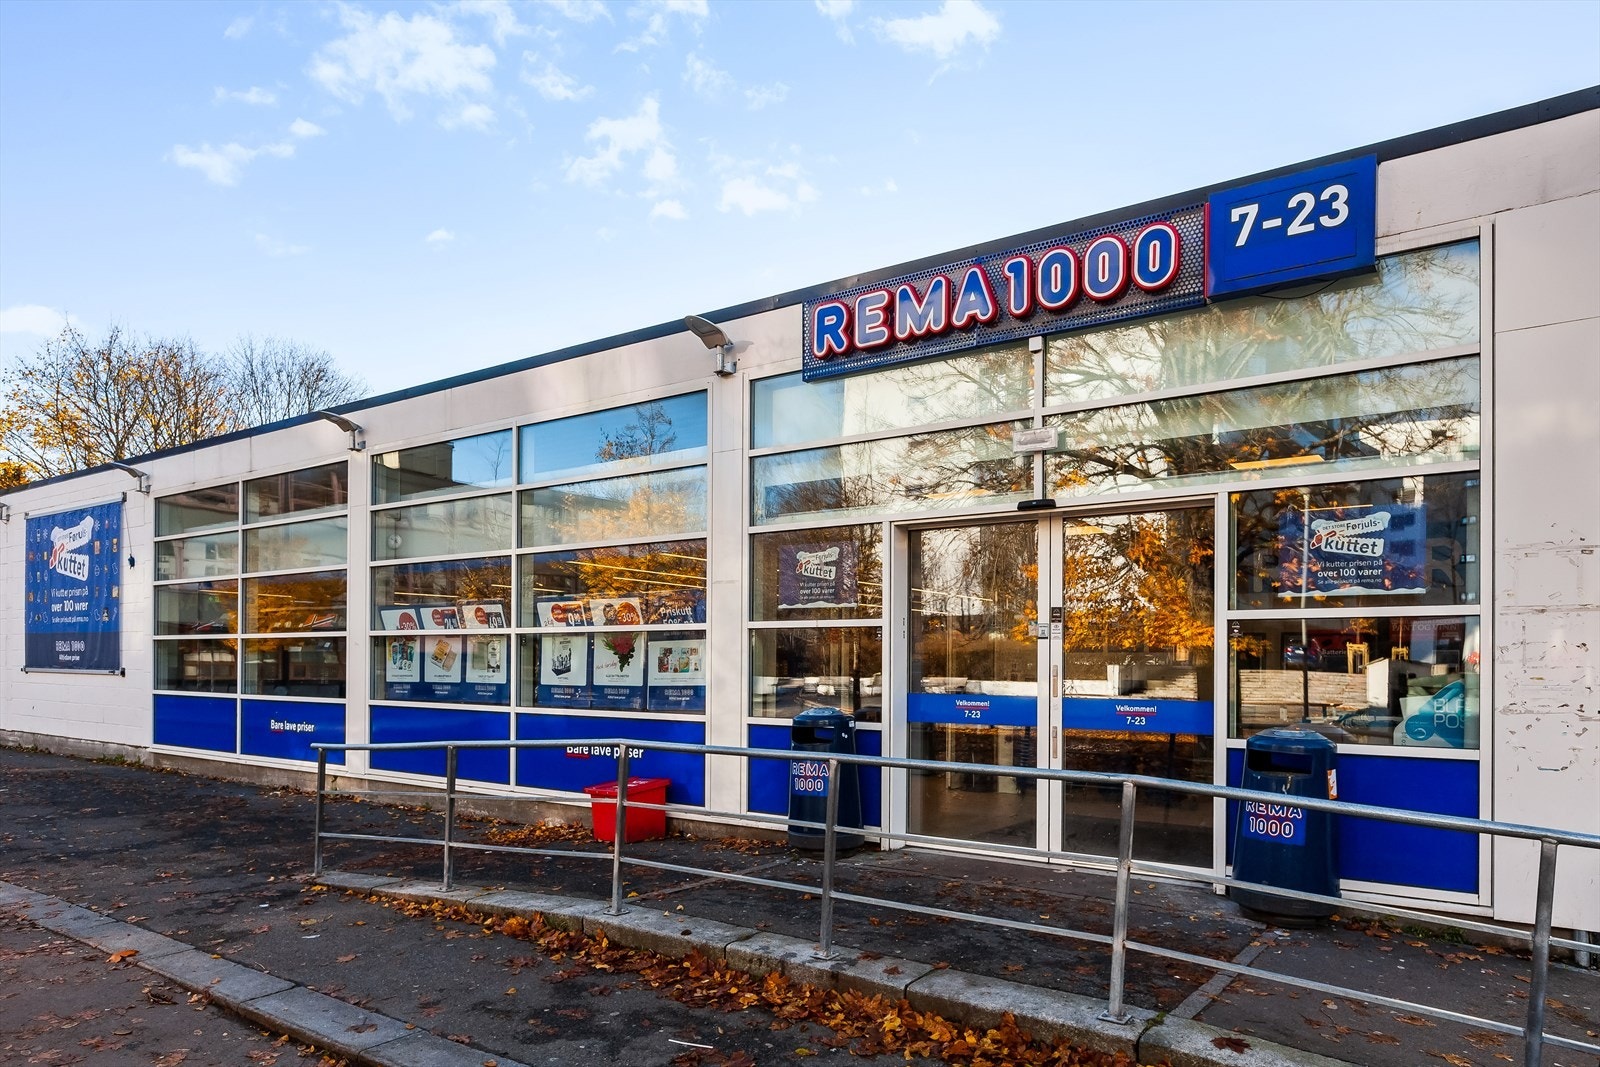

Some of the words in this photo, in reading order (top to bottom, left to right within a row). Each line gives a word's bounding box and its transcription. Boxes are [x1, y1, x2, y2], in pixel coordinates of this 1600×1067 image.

[1230, 184, 1350, 247] 7-23
[813, 263, 998, 359] REMA
[1003, 221, 1182, 320] 1000
[1346, 520, 1380, 530] Førjuls-
[1324, 537, 1378, 554] kuttet
[57, 552, 86, 578] kuttet
[1349, 560, 1371, 568] prisen
[804, 564, 832, 578] kuttet
[1340, 568, 1356, 576] 100
[51, 603, 62, 612] over
[63, 600, 74, 611] 100
[660, 605, 693, 616] Priskutt
[964, 710, 981, 718] 7-23
[1115, 704, 1157, 713] Velkommen!
[270, 719, 284, 729] Bare
[284, 720, 297, 730] lave
[297, 721, 315, 732] priser
[1126, 716, 1146, 725] 7-23
[613, 746, 644, 759] pser
[792, 762, 829, 777] REMA
[794, 777, 824, 791] 1000
[1245, 801, 1302, 819] REMA
[1249, 816, 1294, 838] 1000
